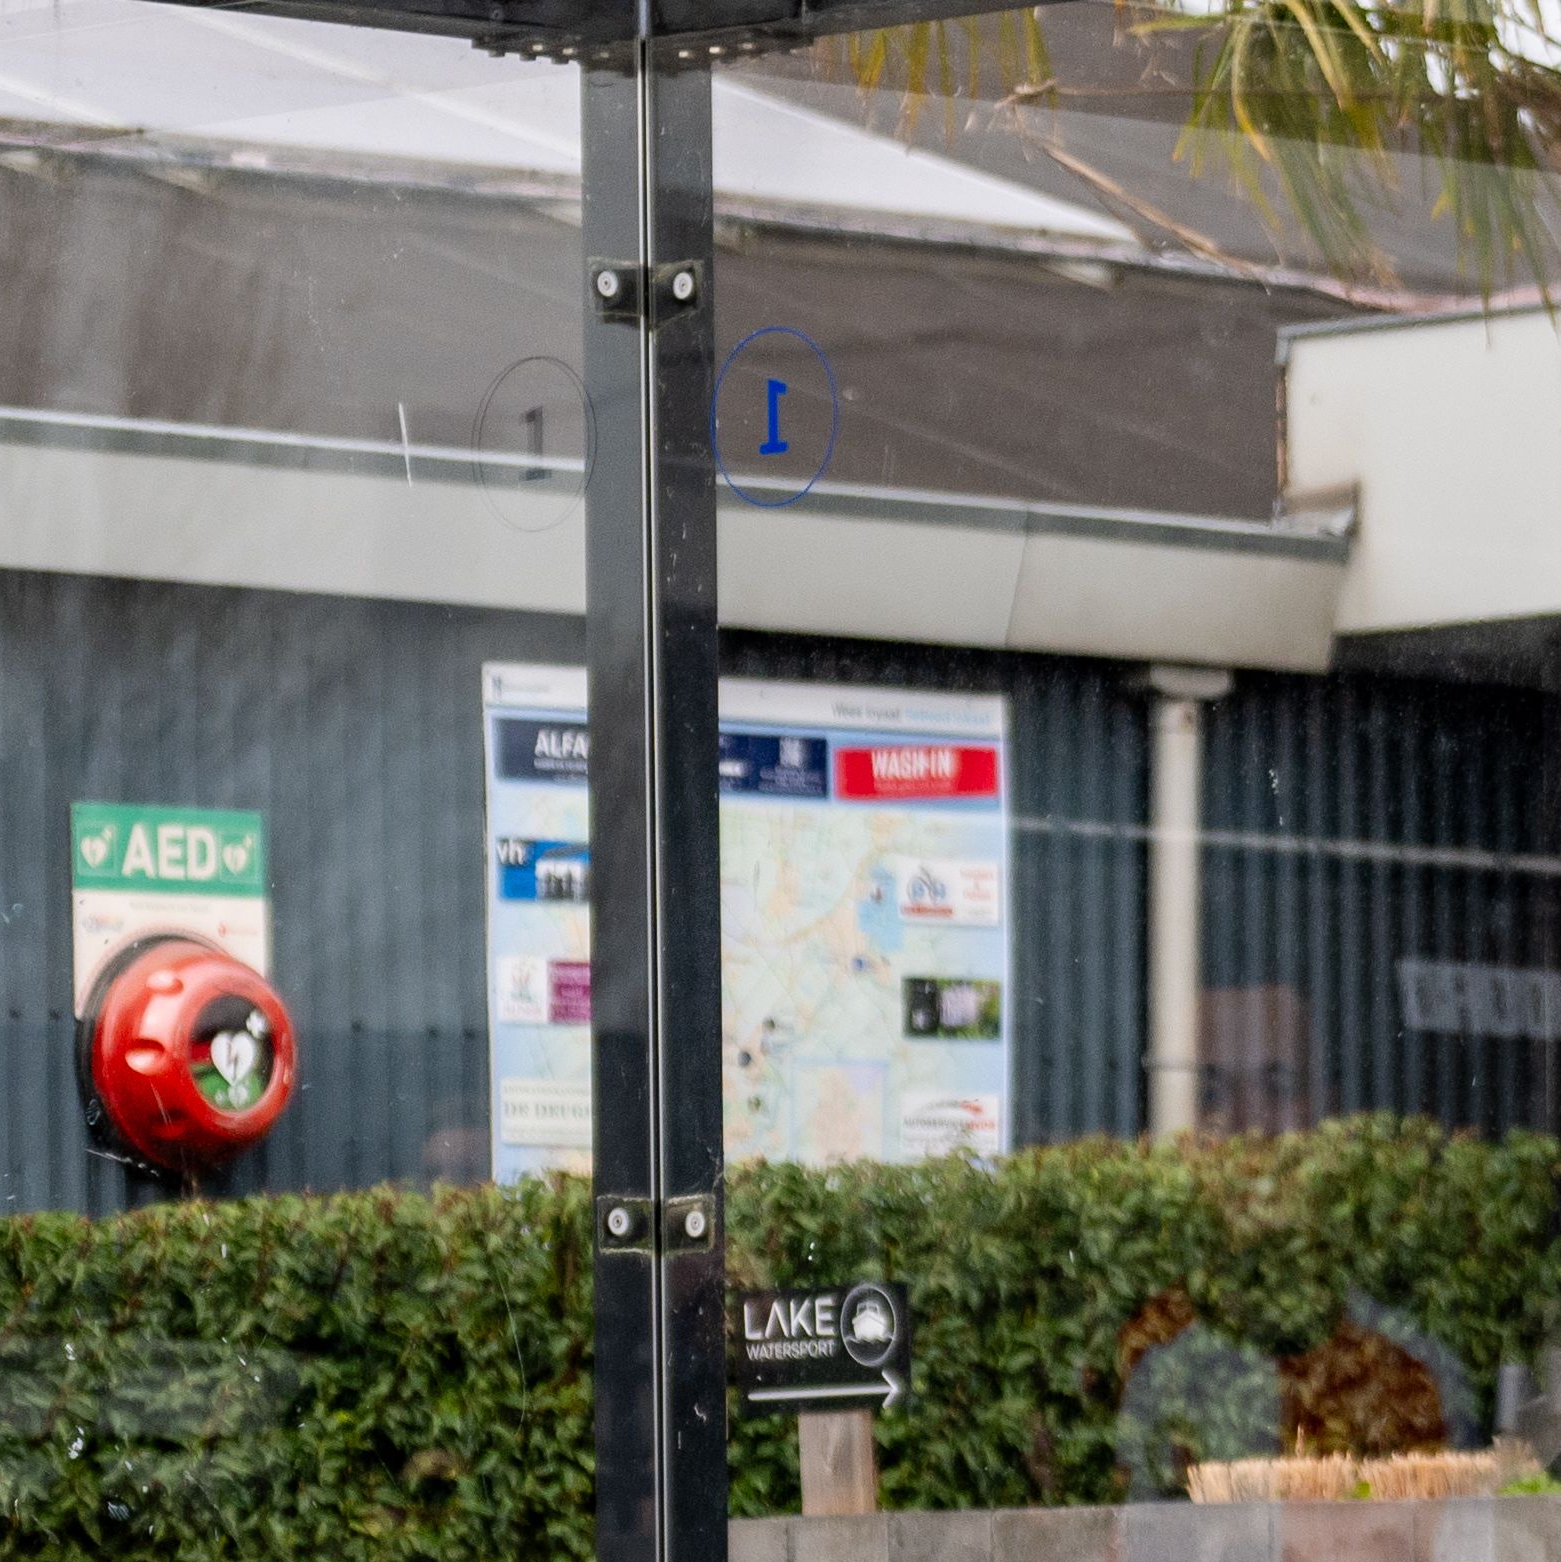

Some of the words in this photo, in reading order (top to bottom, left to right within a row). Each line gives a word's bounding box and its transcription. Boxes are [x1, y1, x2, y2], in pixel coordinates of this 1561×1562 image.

[871, 749, 953, 780] WASH-IN
[121, 823, 217, 881] AED
[743, 1297, 835, 1340] LAKE
[745, 1340, 835, 1361] WATERSPORT
